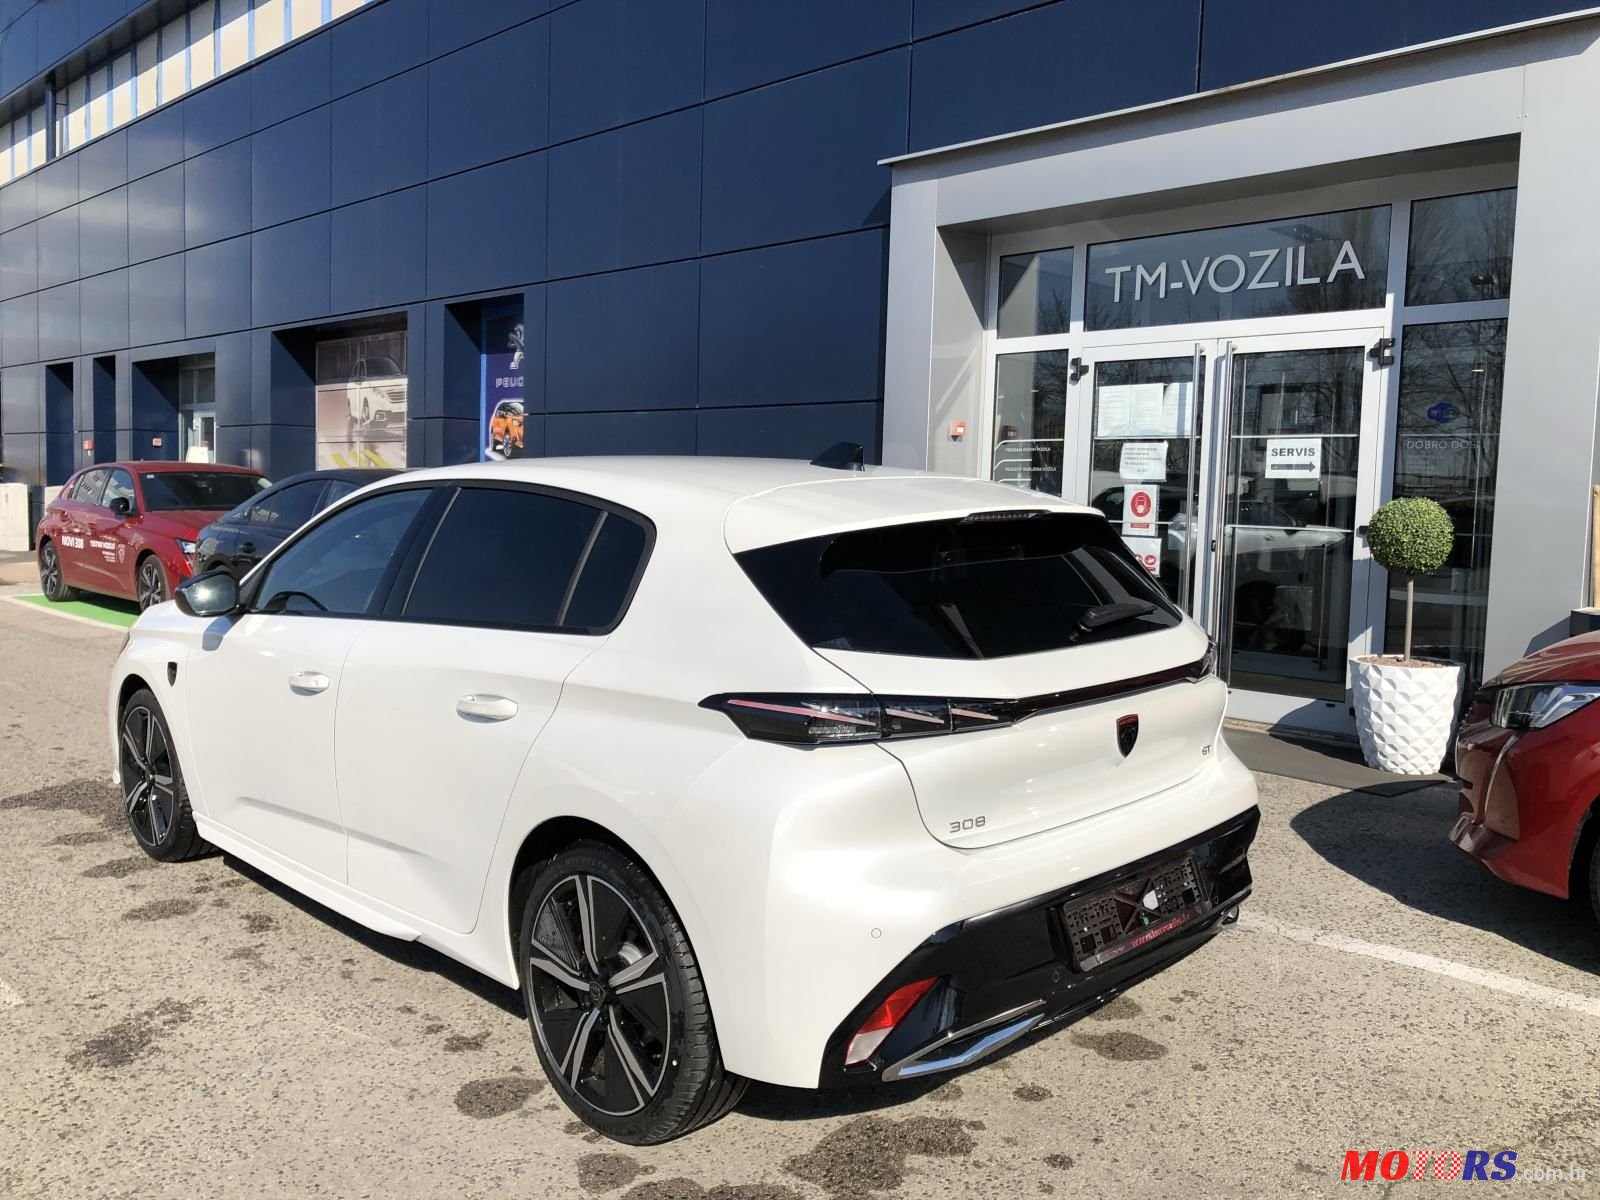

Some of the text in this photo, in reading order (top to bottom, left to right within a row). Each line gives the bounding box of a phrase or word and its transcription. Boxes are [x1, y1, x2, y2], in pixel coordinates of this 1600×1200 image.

[1105, 240, 1365, 302] TM-VOZILA
[1406, 440, 1448, 449] DOBRO
[1271, 447, 1316, 457] SERVIS
[62, 535, 74, 548] NOVI
[949, 815, 986, 834] 308
